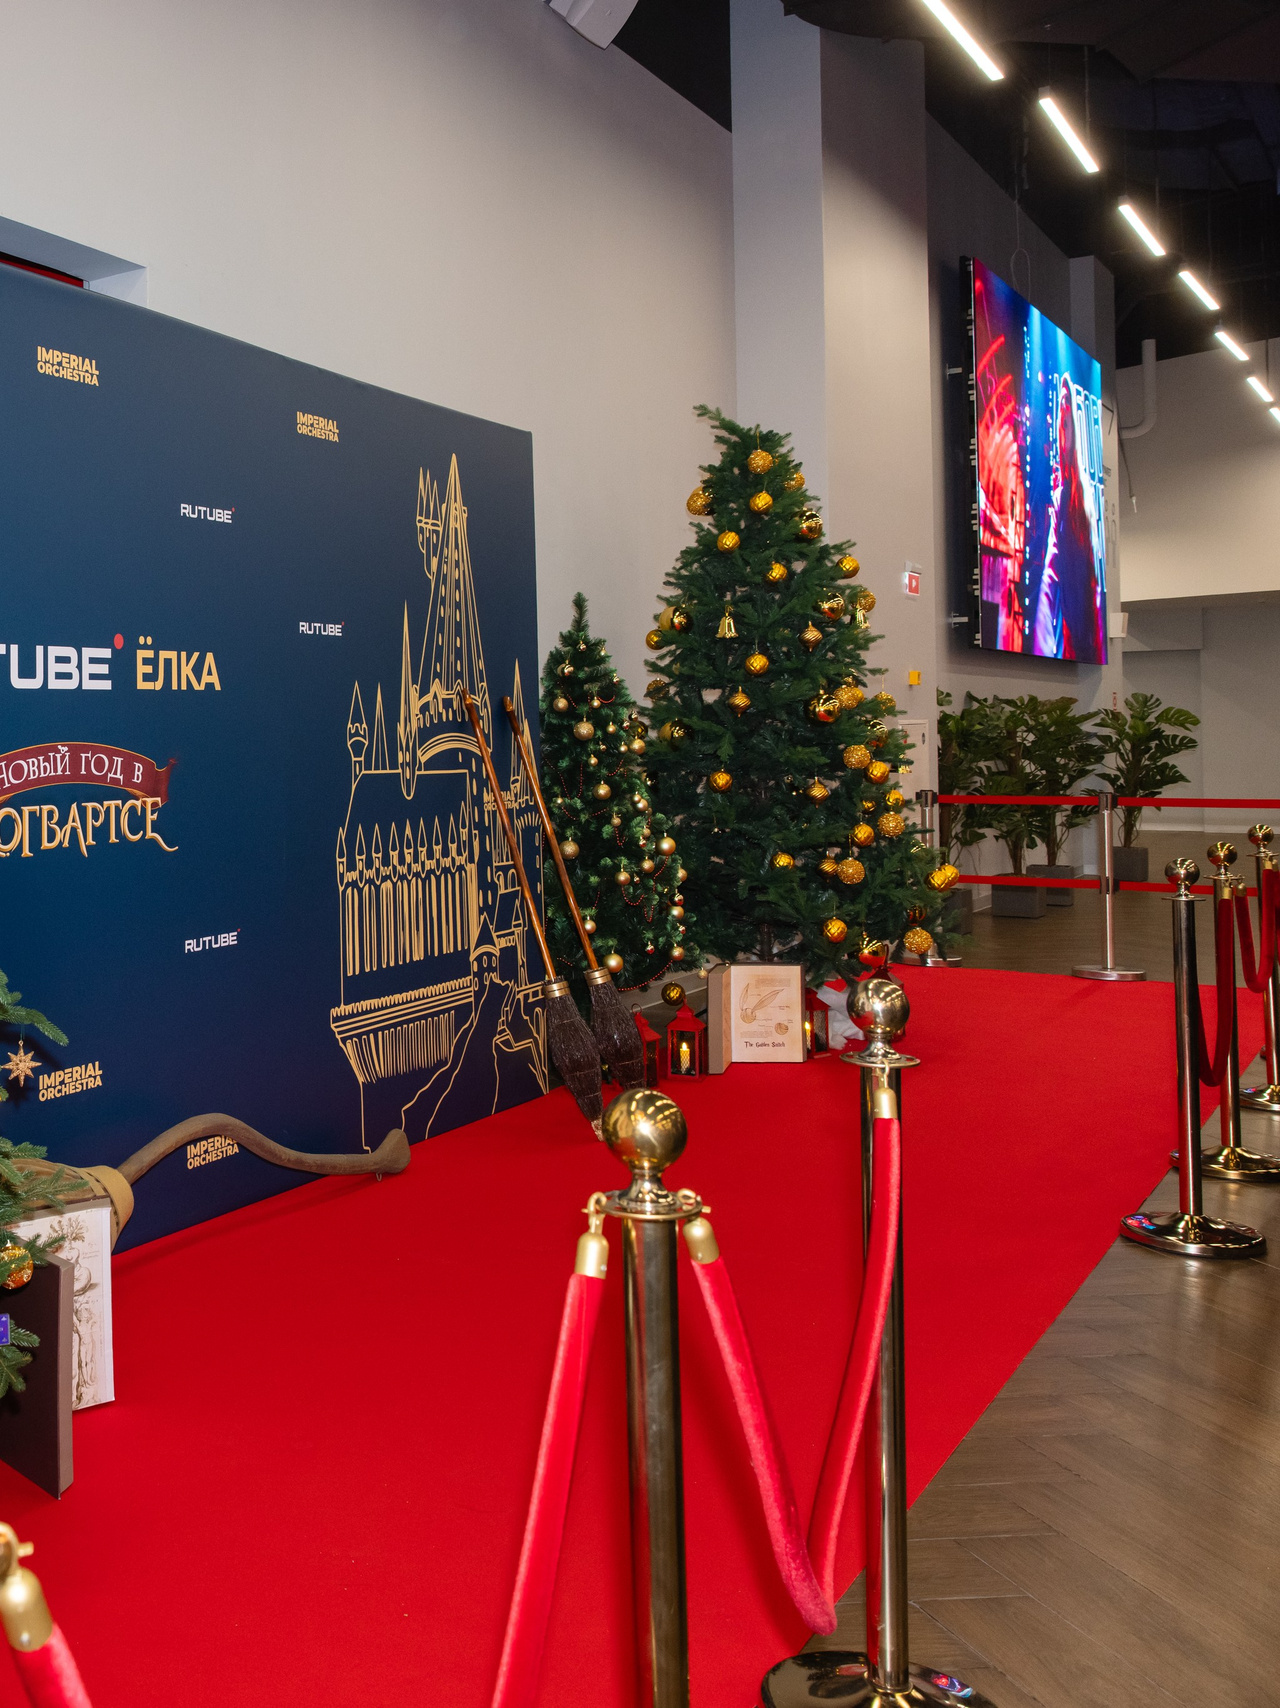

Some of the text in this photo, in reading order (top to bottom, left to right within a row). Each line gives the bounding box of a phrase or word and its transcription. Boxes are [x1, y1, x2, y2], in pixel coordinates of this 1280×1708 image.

[37, 346, 100, 375] IMPERIAL
[37, 361, 100, 386] ORCHESTRA
[296, 411, 339, 433] IMPERIAL
[297, 424, 339, 442] ORCHESTRA
[180, 503, 232, 523] RUTUBE
[299, 621, 342, 636] RUTUBE
[136, 635, 221, 691] ЁЛКА
[80, 751, 124, 785] ГОД
[184, 932, 238, 953] RUTUBE
[39, 1061, 102, 1090] IMPERIAL
[38, 1076, 102, 1102] ORCHESTRA
[187, 1144, 239, 1170] ORCHESTRA
